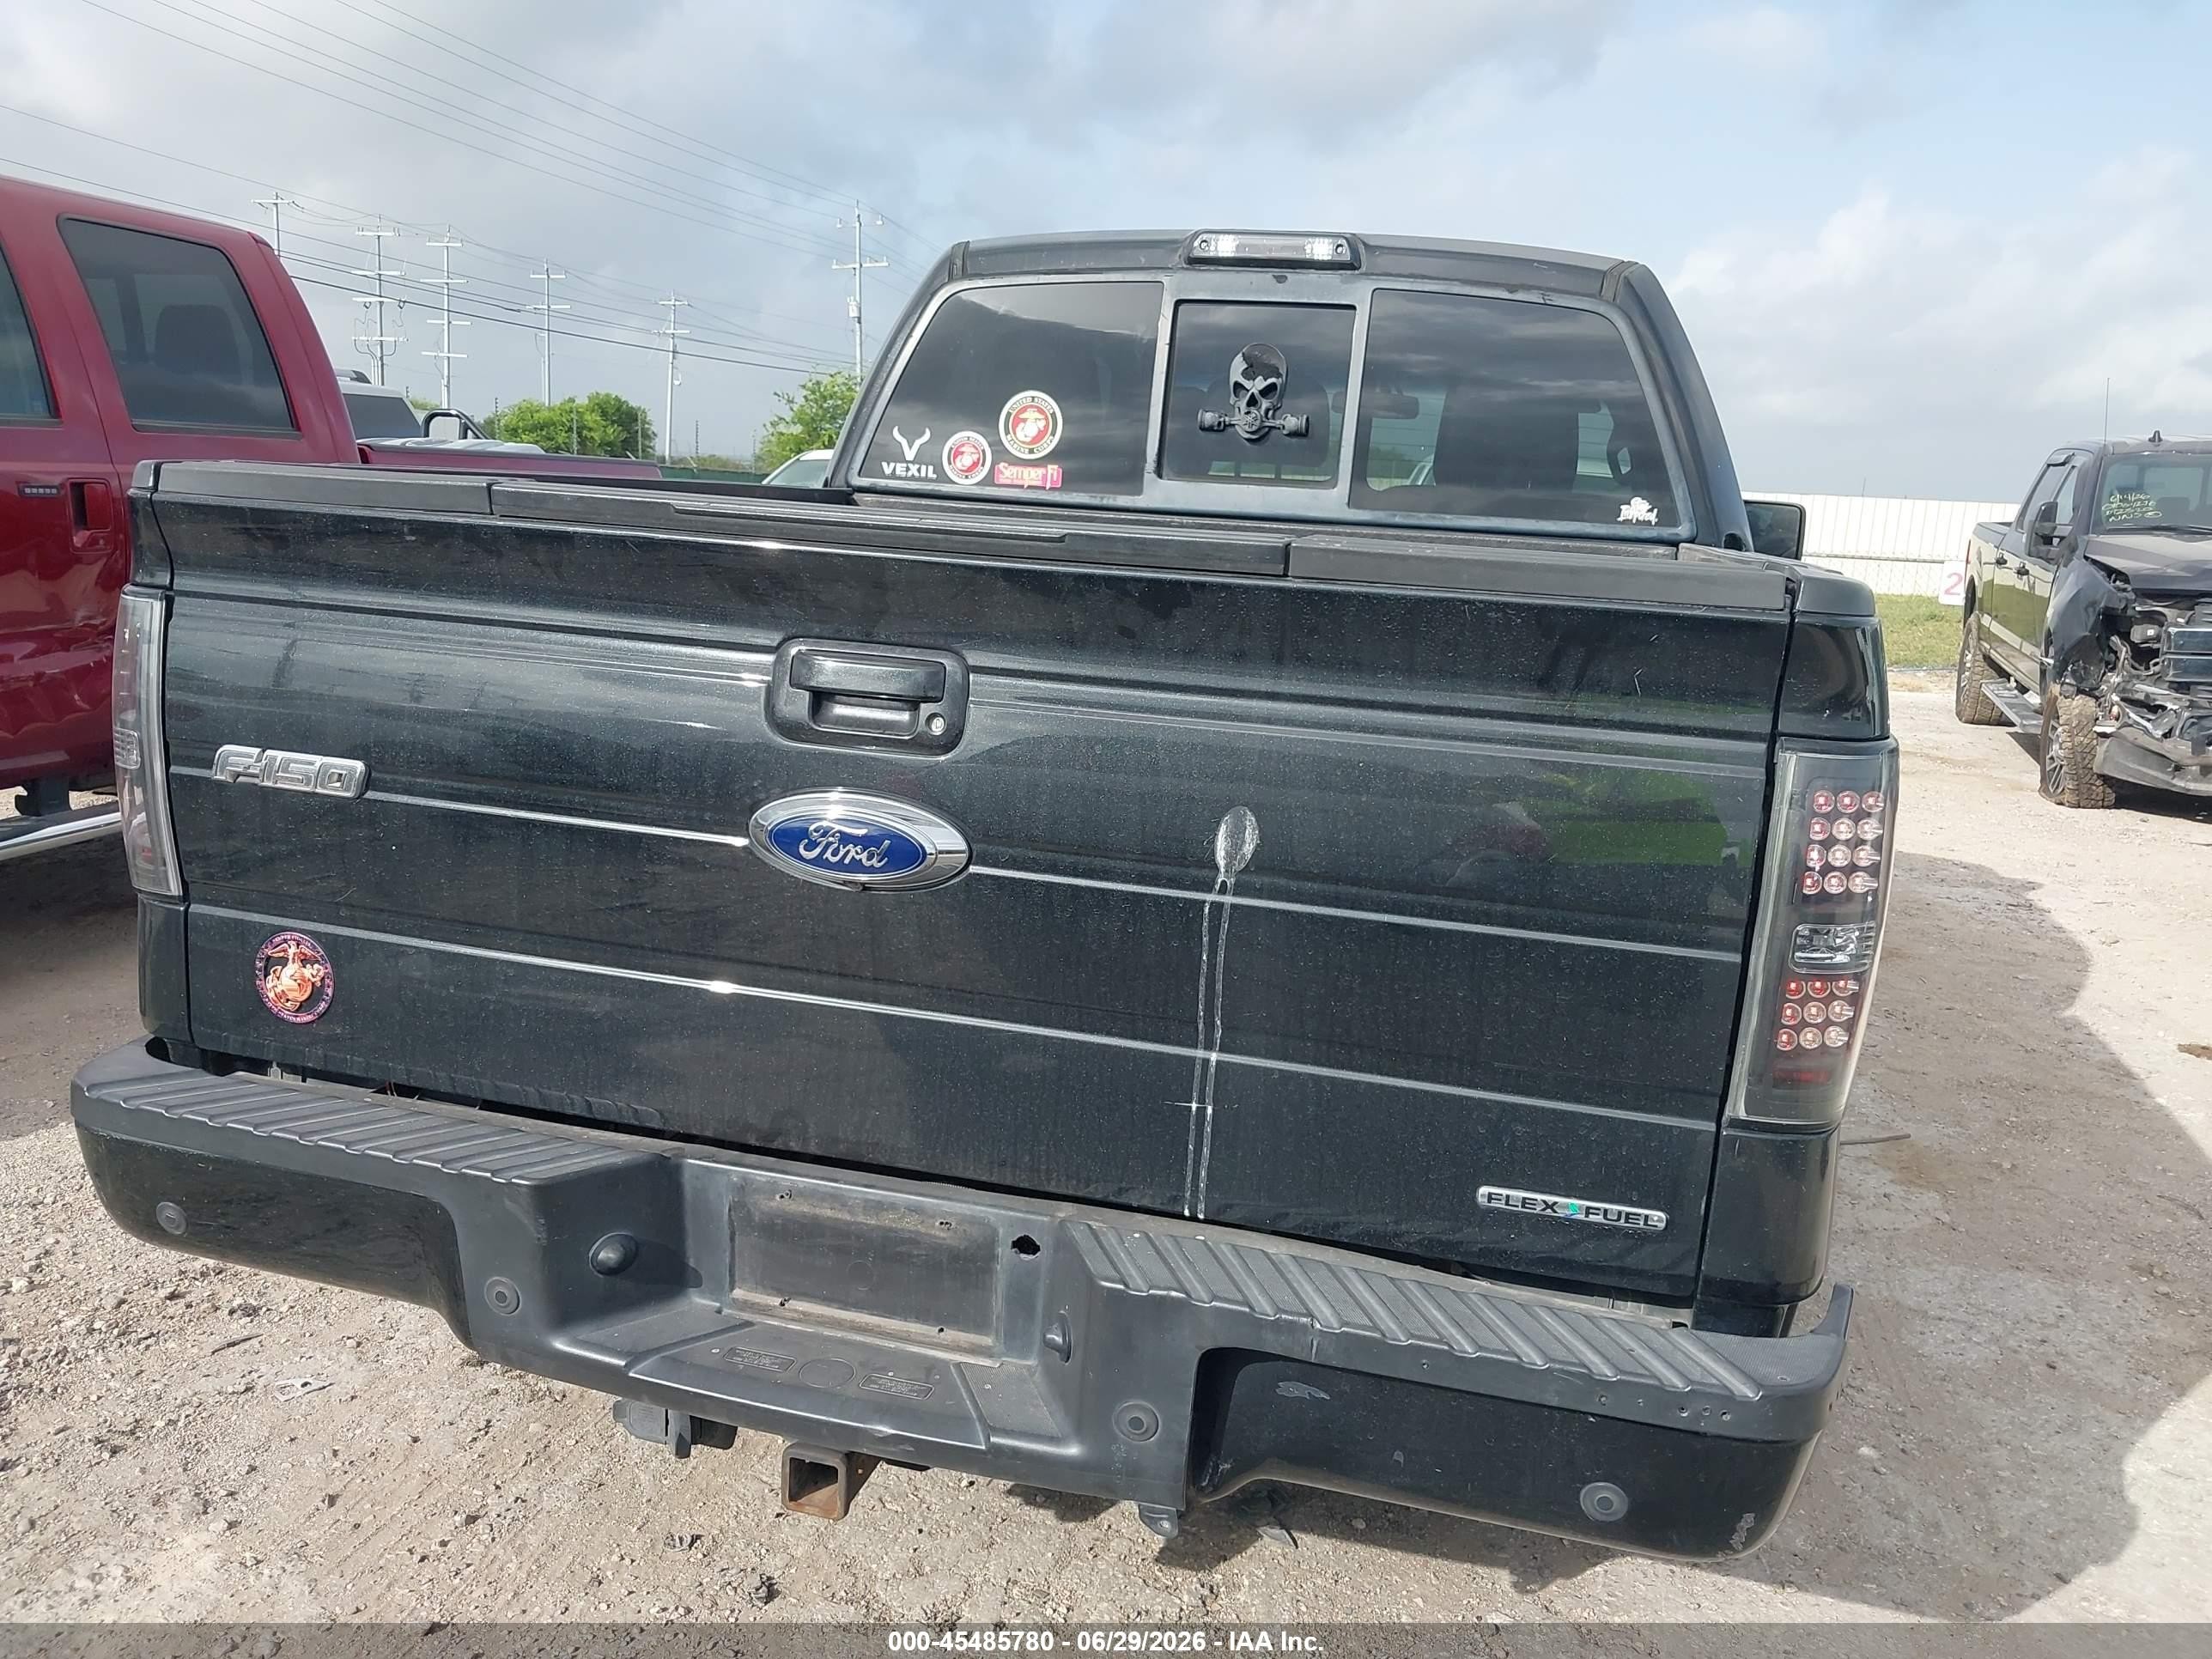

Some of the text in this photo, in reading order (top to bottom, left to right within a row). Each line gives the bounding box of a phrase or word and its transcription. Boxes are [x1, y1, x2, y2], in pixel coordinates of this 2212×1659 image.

[881, 461, 937, 479] VEXIL
[999, 462, 1045, 488] Semper
[213, 744, 371, 800] F-150
[799, 820, 891, 868] Ford
[1486, 1191, 1659, 1228] FLEX FUEL
